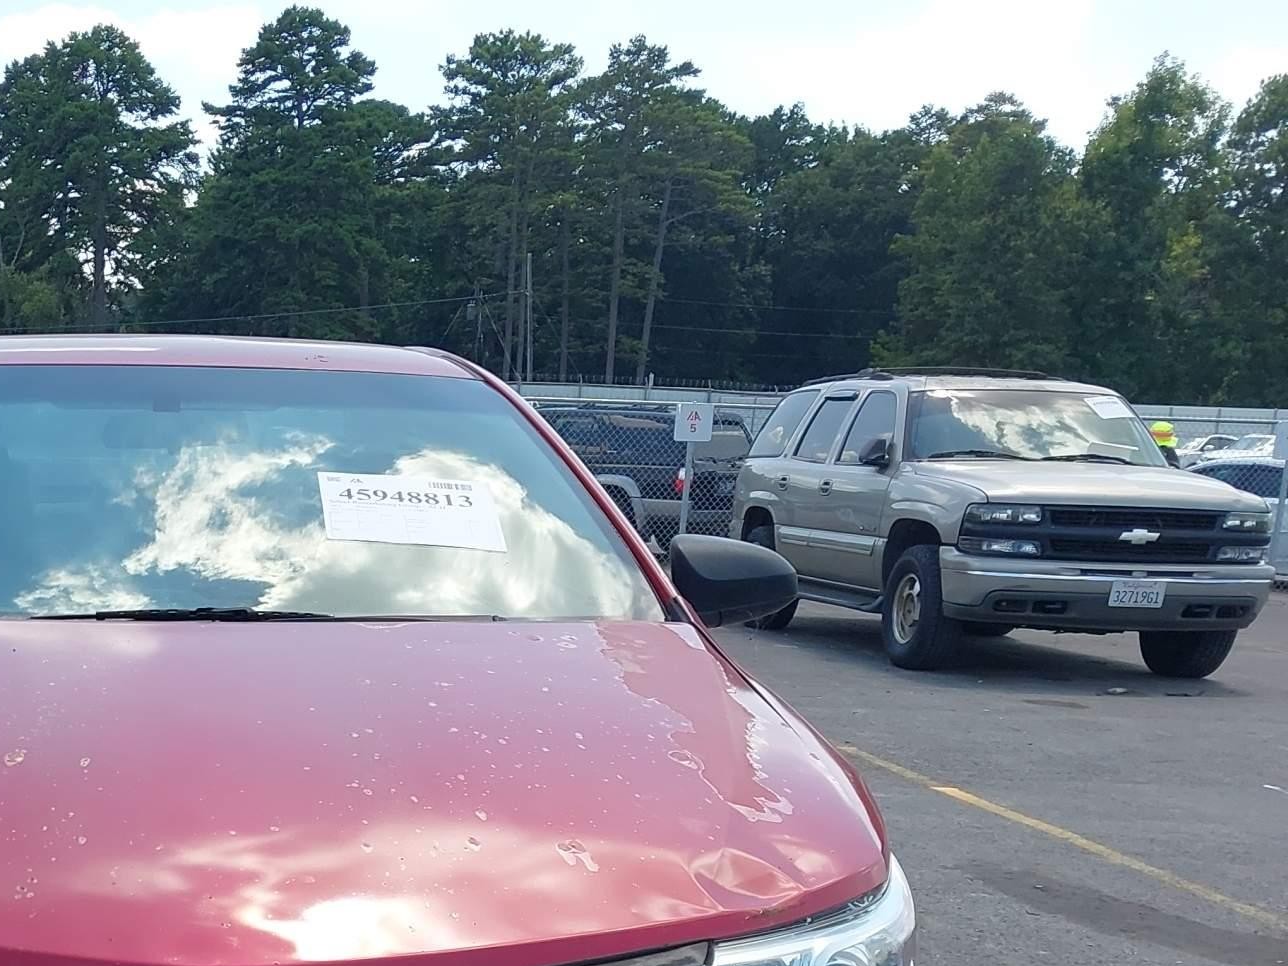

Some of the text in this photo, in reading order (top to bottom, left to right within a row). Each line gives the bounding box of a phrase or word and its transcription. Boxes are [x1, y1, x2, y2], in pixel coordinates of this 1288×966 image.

[689, 423, 697, 433] 5
[339, 488, 473, 508] 45948813
[1113, 590, 1160, 604] 32719G1
